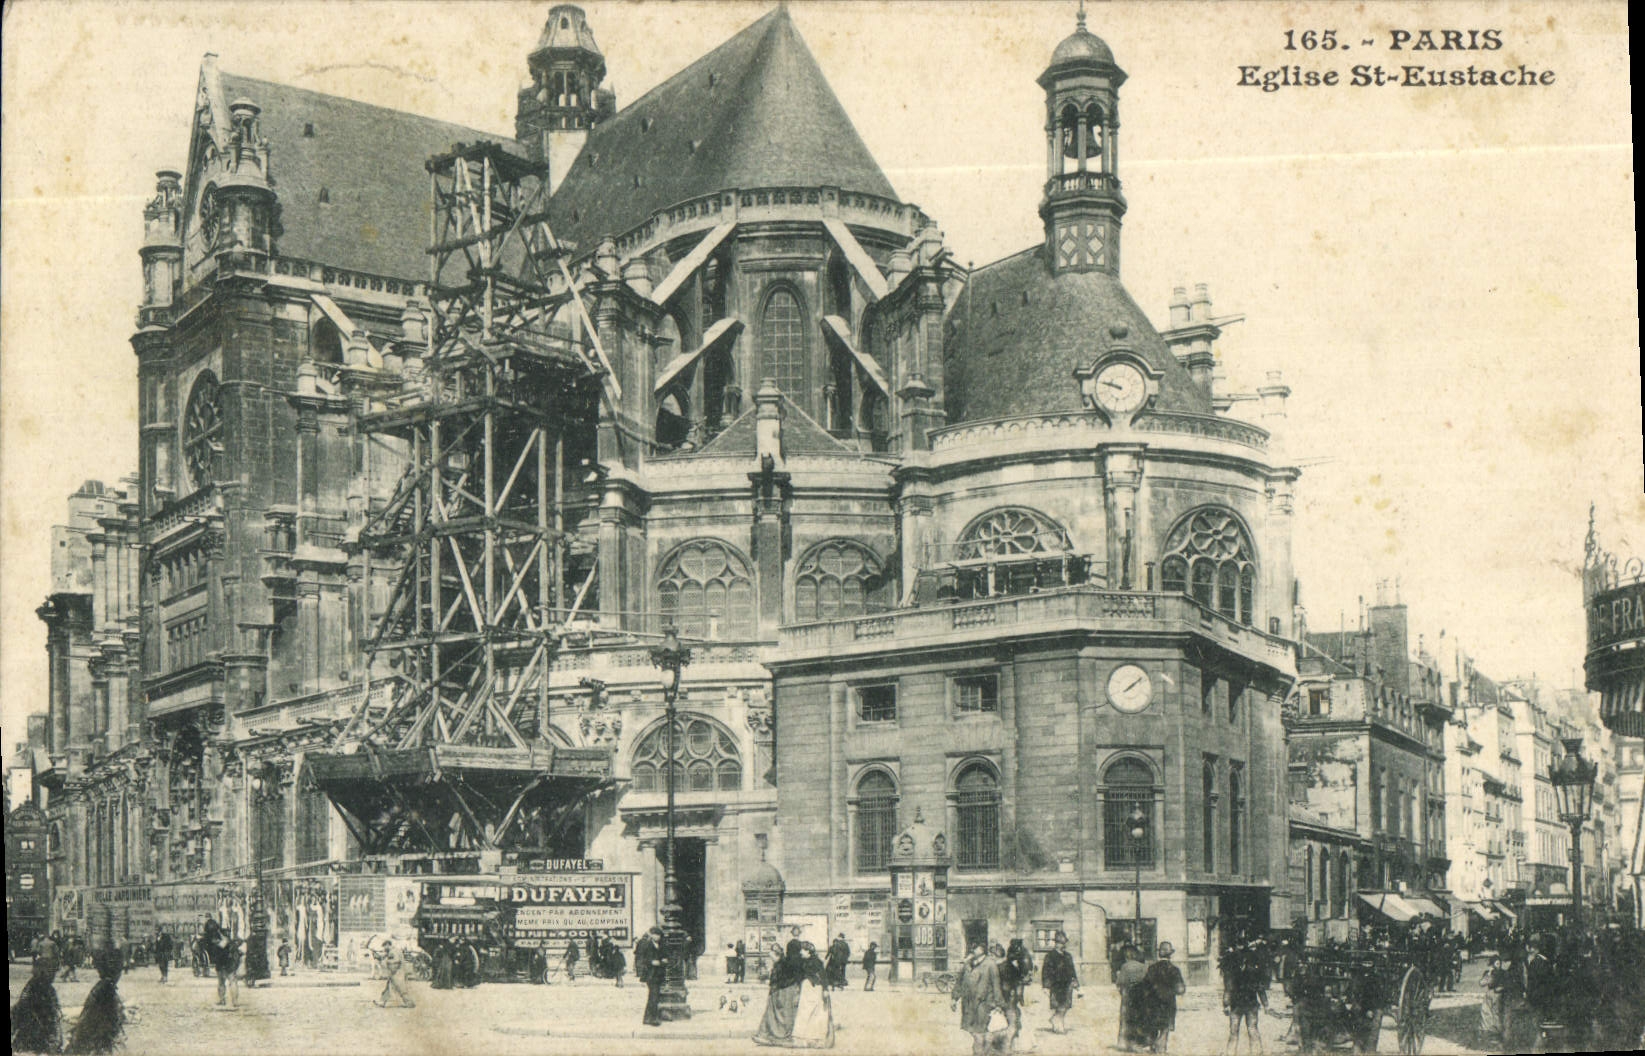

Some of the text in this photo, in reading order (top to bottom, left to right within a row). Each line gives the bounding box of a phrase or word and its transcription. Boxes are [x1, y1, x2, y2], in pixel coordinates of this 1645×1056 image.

[546, 859, 588, 870] DUFAYEL
[511, 887, 623, 902] DUFAYEL
[915, 927, 934, 945] JOB
